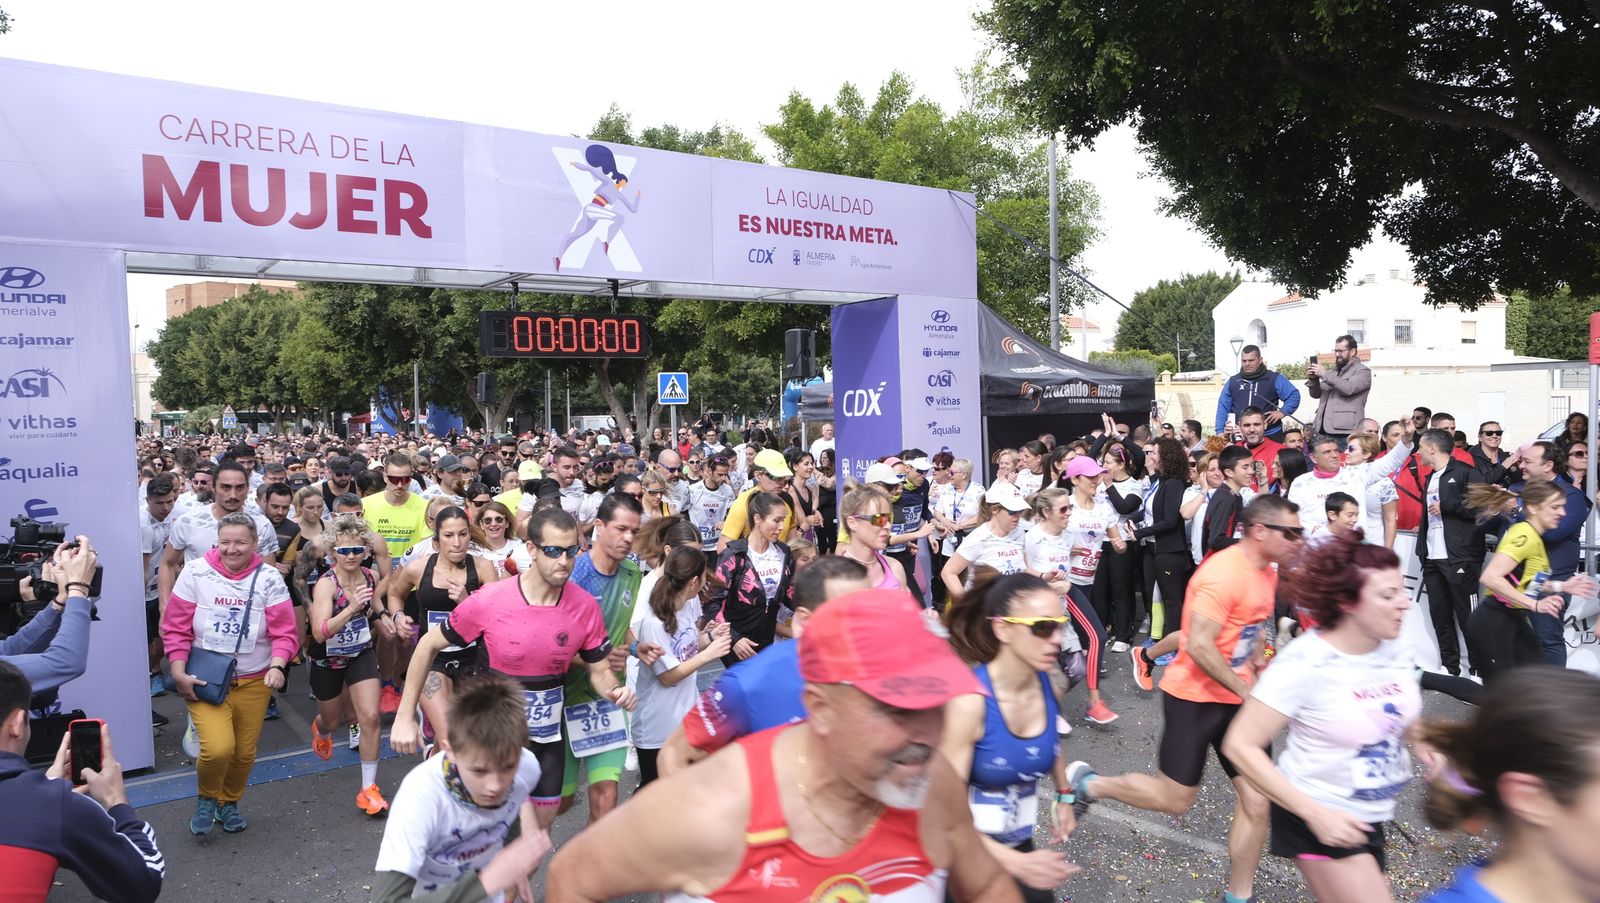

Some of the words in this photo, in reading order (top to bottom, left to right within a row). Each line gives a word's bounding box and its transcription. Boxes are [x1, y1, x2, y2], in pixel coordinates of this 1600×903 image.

[159, 113, 320, 157] CARRERA
[330, 134, 369, 162] DE
[381, 141, 415, 168] LA
[141, 153, 432, 239] MUJER
[766, 186, 789, 206] LA
[791, 189, 874, 216] IGUALDAD
[738, 213, 762, 234] ES
[766, 216, 846, 242] NUESTRA
[848, 225, 899, 246] META.
[748, 247, 775, 264] CDX
[806, 251, 836, 262] ALMERÍA
[0, 292, 66, 304] UNDAI
[0, 306, 56, 317] merialva
[513, 316, 640, 353] 00:00:00
[923, 324, 958, 332] HYUNDAI
[0, 333, 74, 349] cajamar
[933, 348, 961, 358] cajamar
[928, 374, 952, 387] CASI
[843, 386, 884, 417] CDX
[936, 397, 961, 406] vithas
[8, 414, 77, 430] vithas
[8, 432, 25, 440] vivir
[27, 432, 45, 440] para
[46, 431, 78, 439] cuidarte
[932, 425, 961, 437] aqualia
[0, 462, 78, 483] aqualia
[997, 549, 1019, 557] MUJER
[760, 567, 780, 576] UJER
[337, 630, 361, 643] 337
[581, 713, 611, 732] 376
